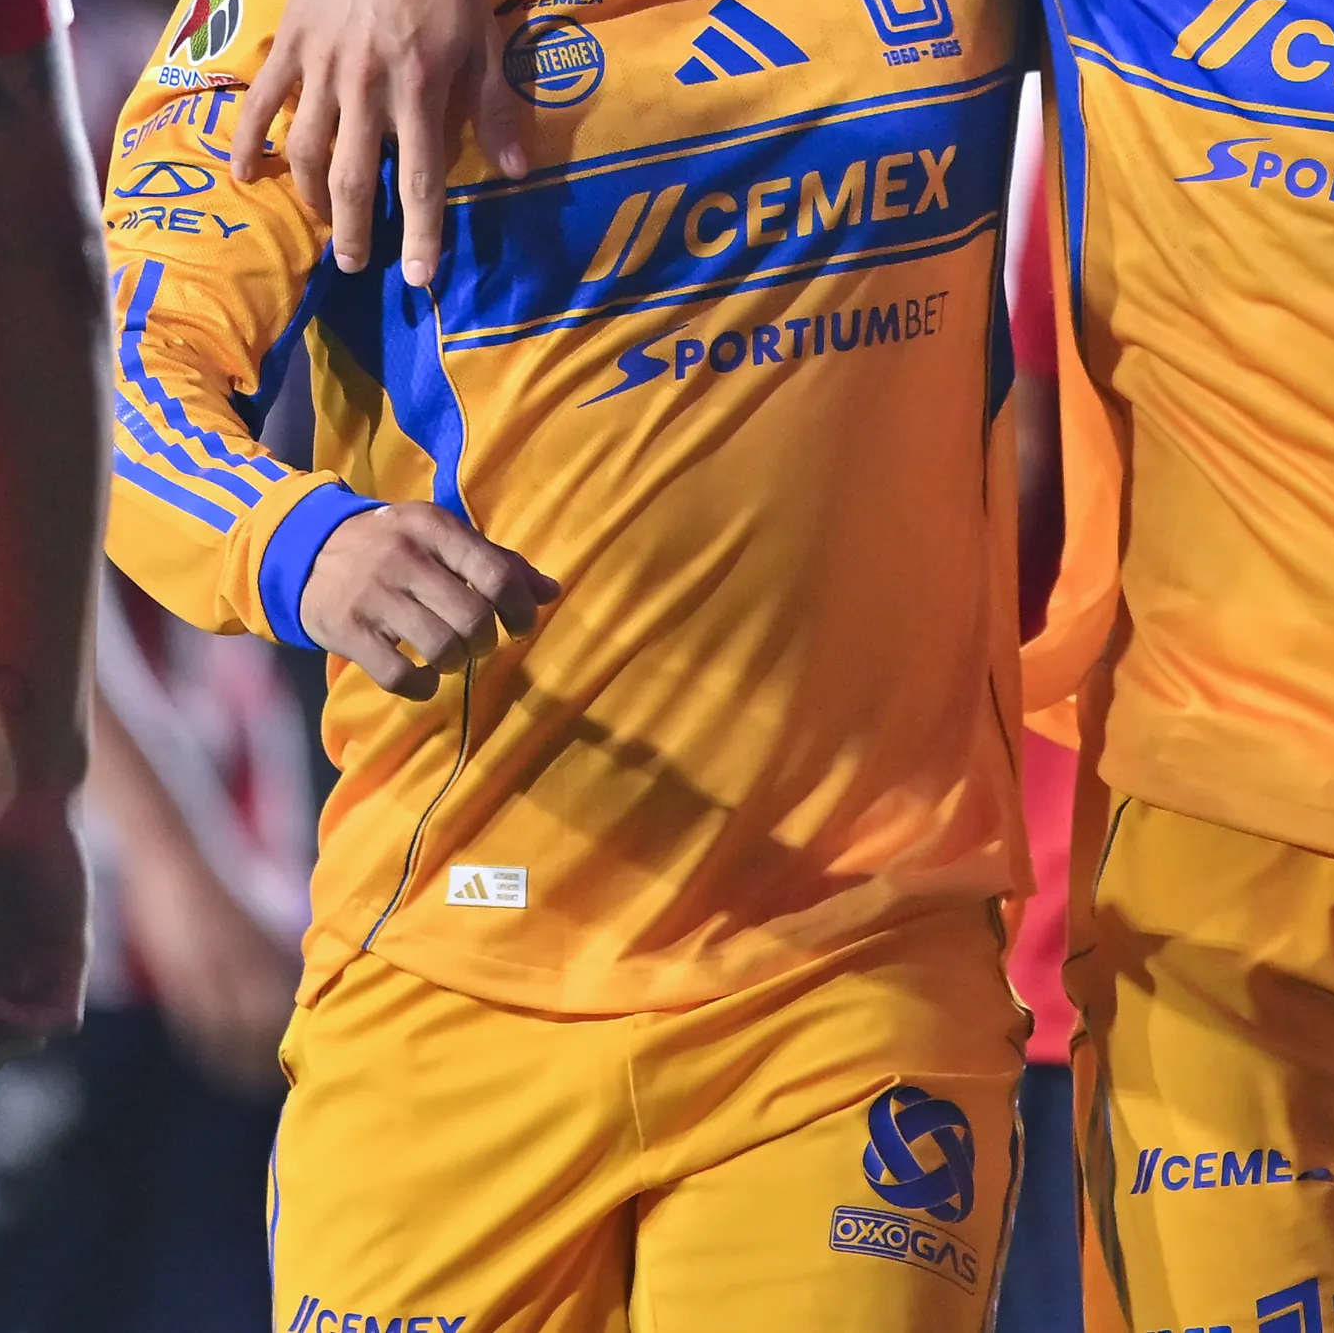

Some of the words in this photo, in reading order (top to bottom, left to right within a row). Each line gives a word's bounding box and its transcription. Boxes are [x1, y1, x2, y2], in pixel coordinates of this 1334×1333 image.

[158, 66, 207, 88] BBVA
[882, 47, 921, 66] 1960
[121, 93, 203, 159] smart
[683, 145, 957, 259] CEMEX
[1161, 1148, 1334, 1192] CEME
